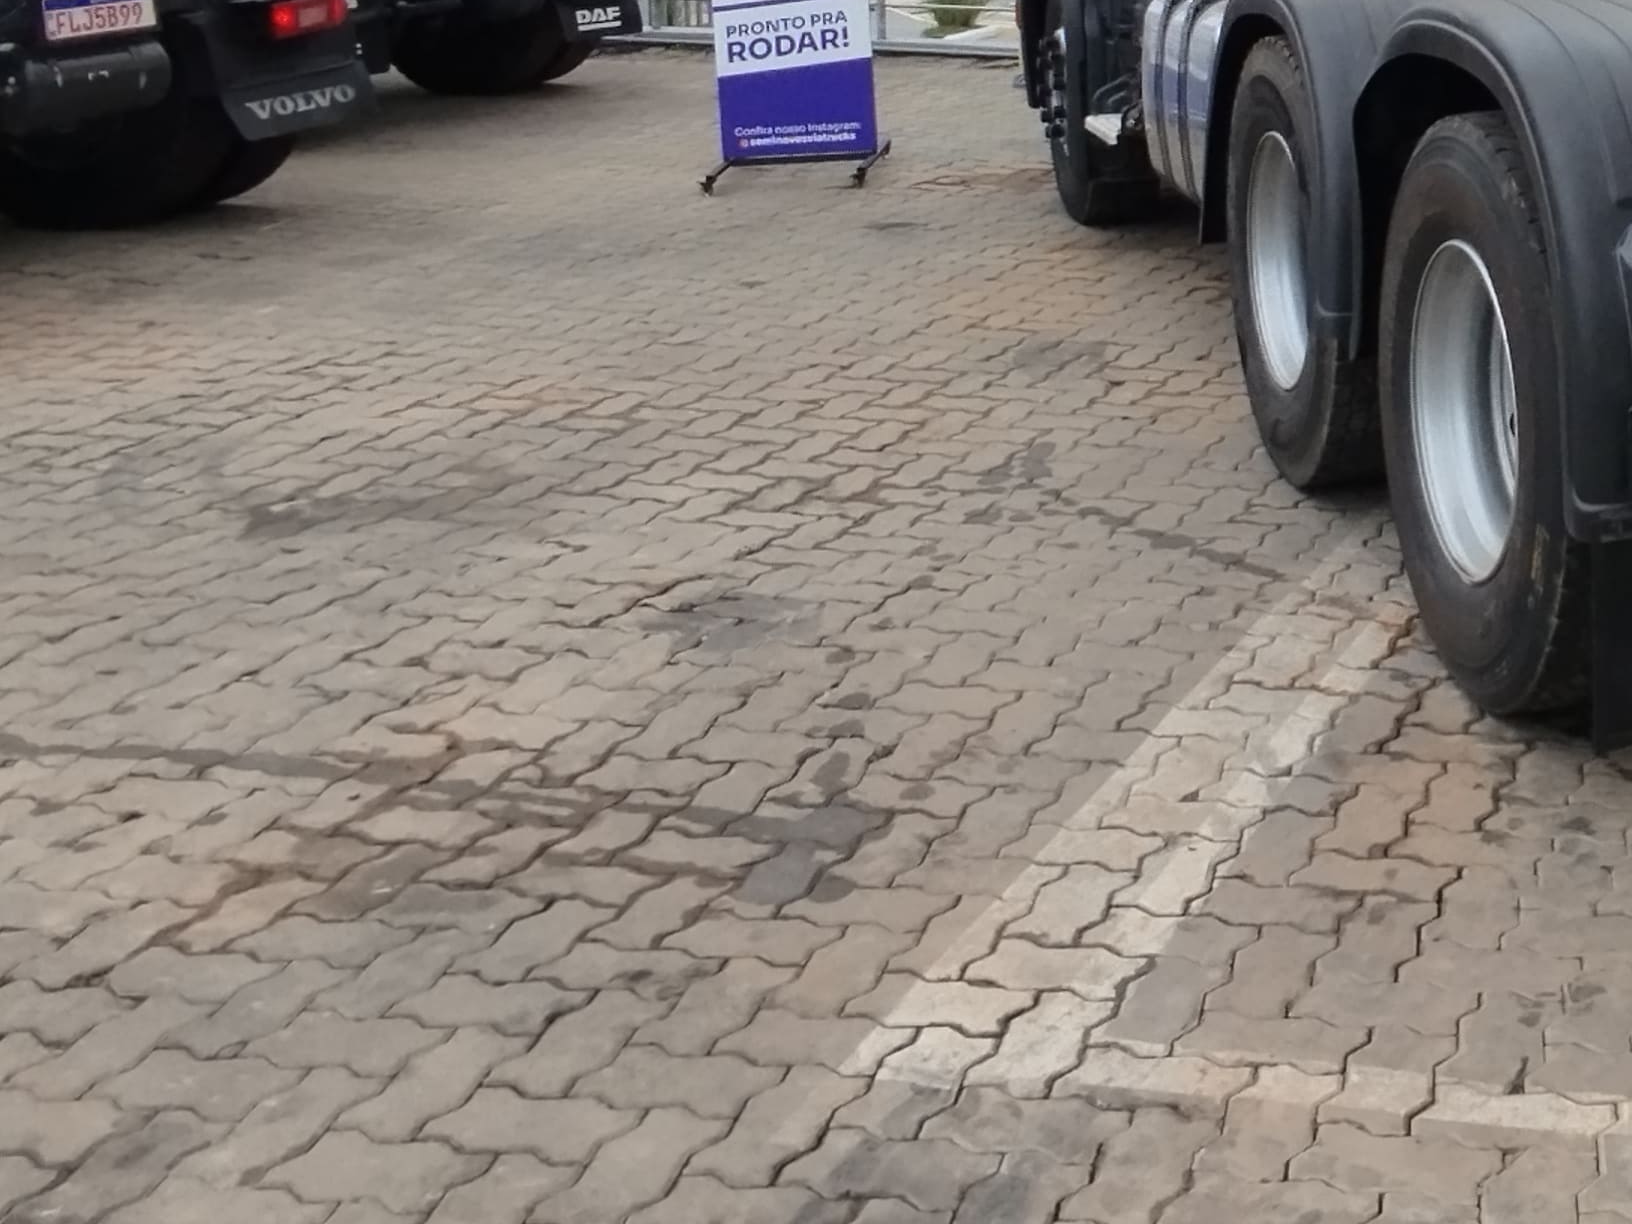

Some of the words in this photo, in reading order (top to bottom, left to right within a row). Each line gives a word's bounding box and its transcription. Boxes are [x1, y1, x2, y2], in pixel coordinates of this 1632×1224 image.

[56, 2, 143, 34] FLJ5B99
[575, 6, 621, 23] DAF
[726, 16, 806, 38] PRONTO
[810, 10, 848, 26] PRA
[727, 26, 850, 63] RODAR!
[246, 84, 356, 119] VOLVO
